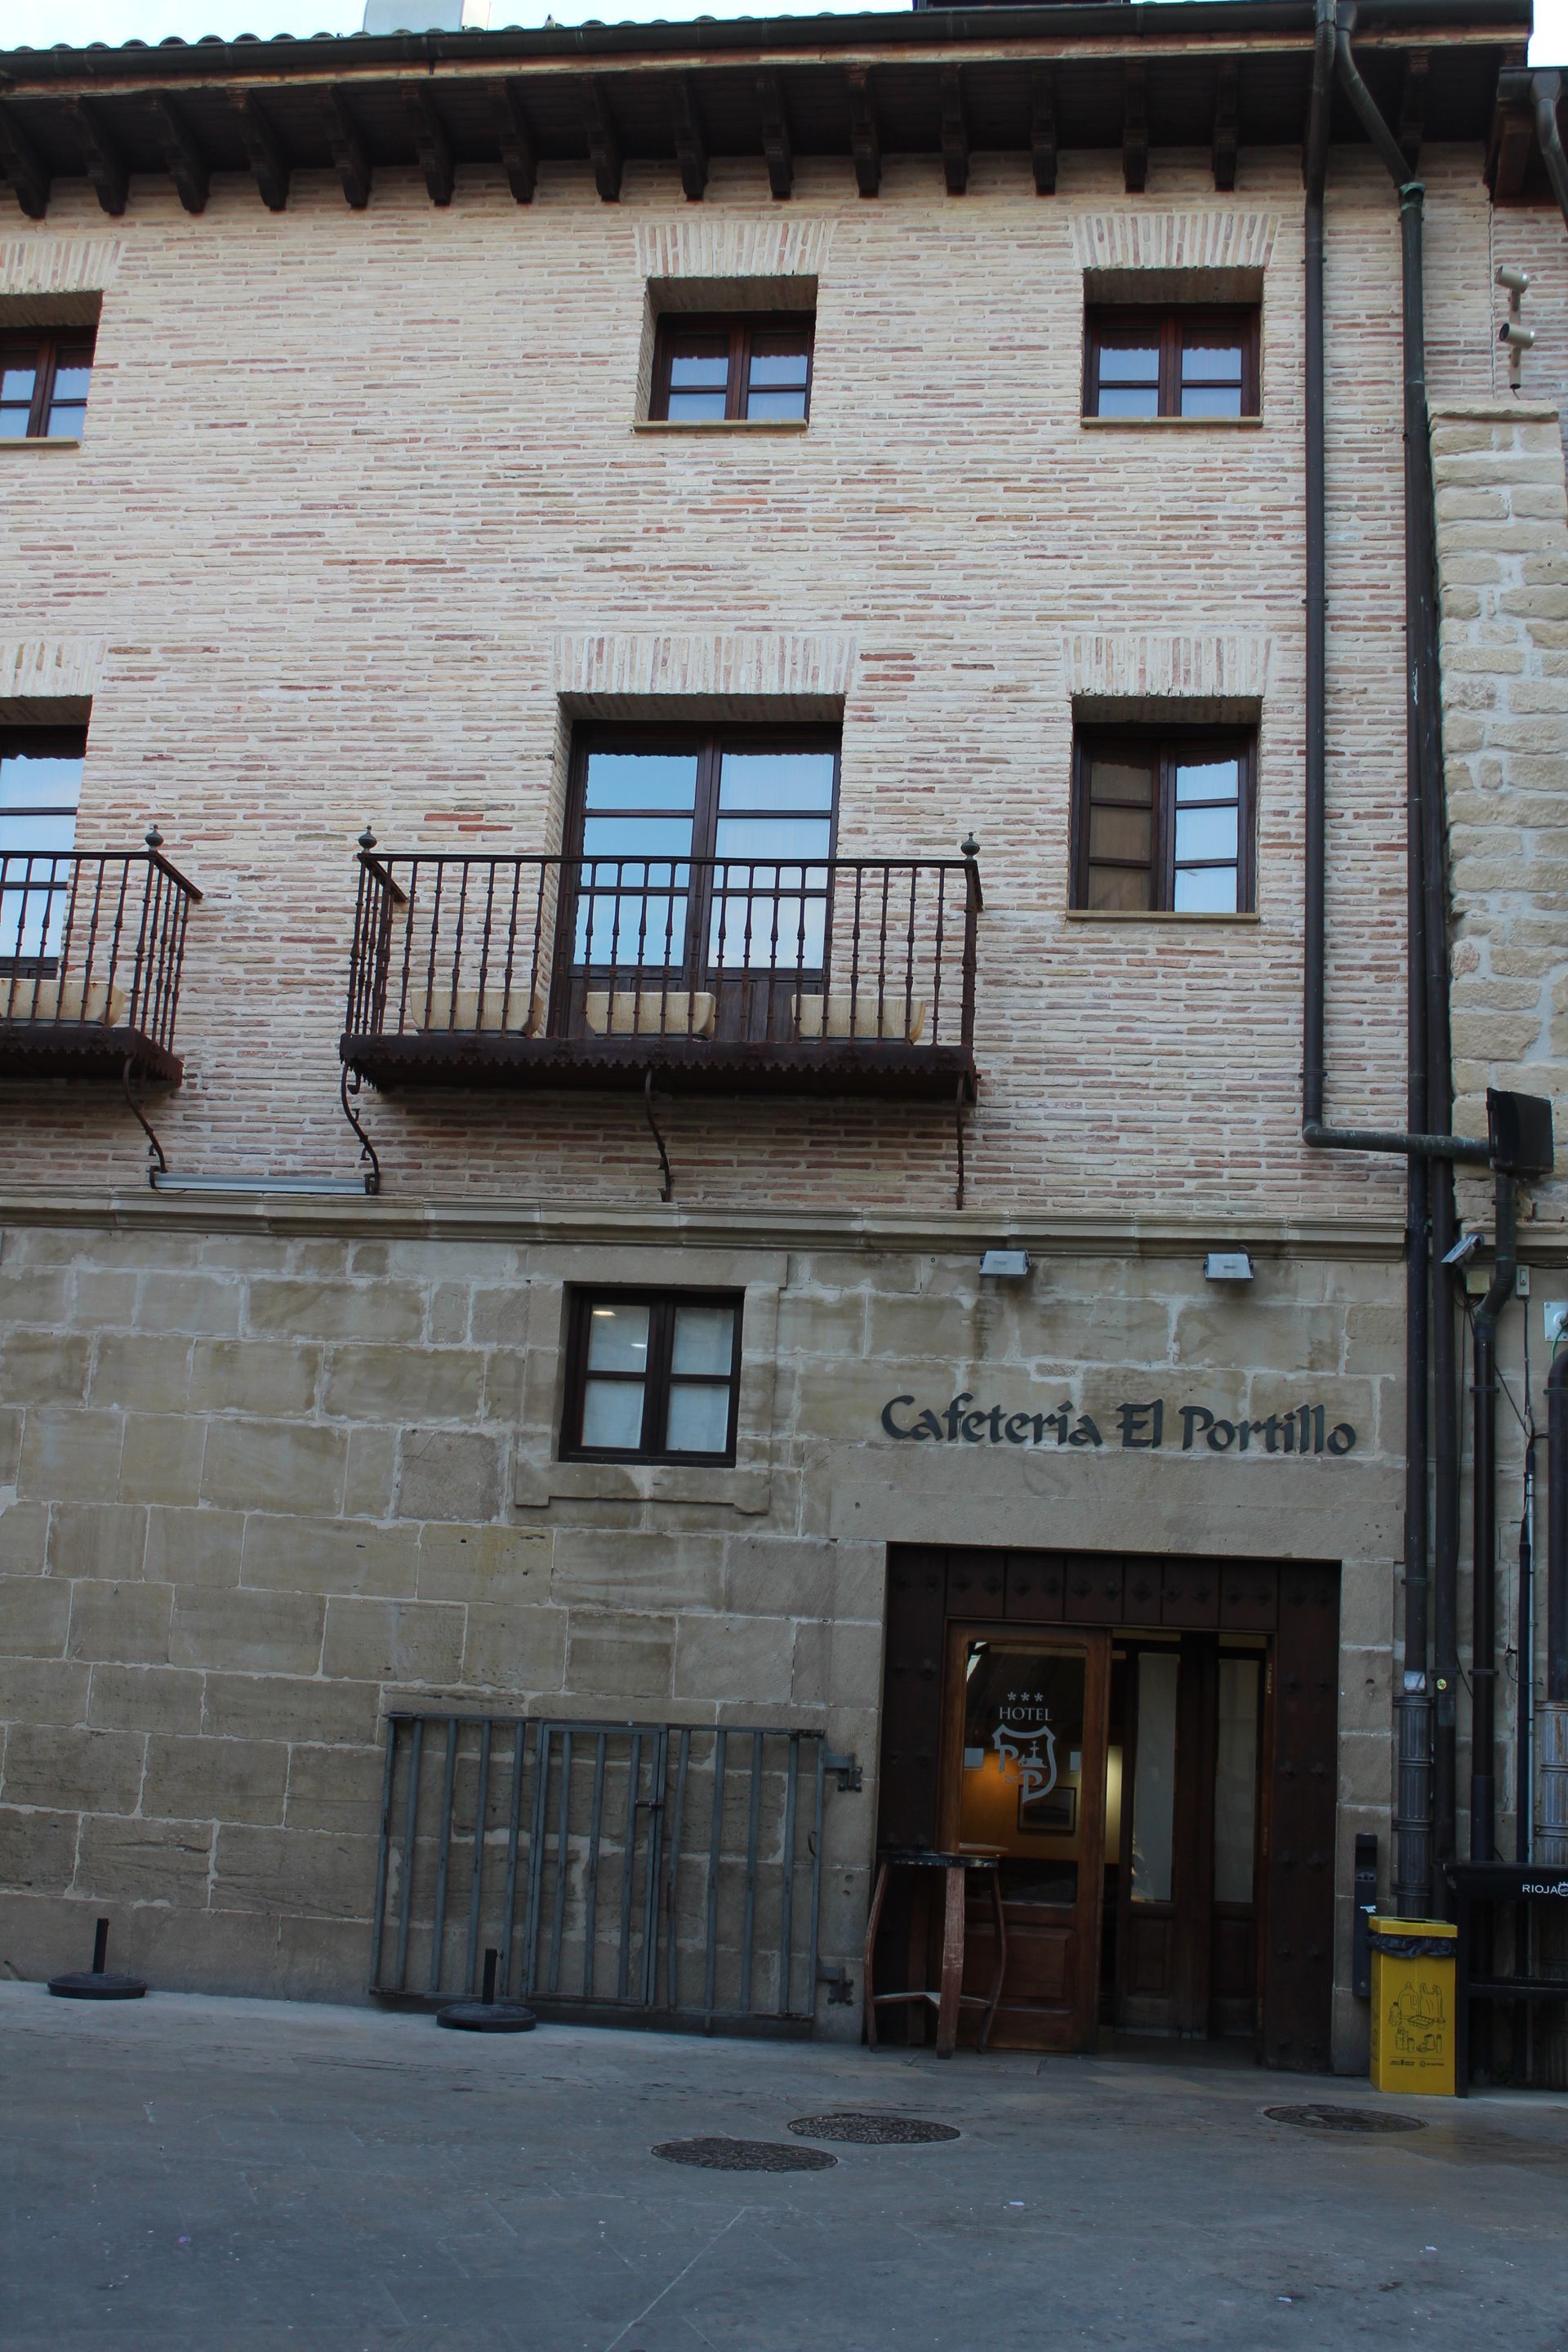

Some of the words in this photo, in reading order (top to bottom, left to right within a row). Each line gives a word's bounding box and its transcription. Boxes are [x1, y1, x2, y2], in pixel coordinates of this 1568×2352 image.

[1116, 1398, 1163, 1449] El
[1178, 1404, 1356, 1455] Portillo
[999, 1706, 1053, 1722] HOTEL
[1521, 1883, 1558, 1895] RIOJA
